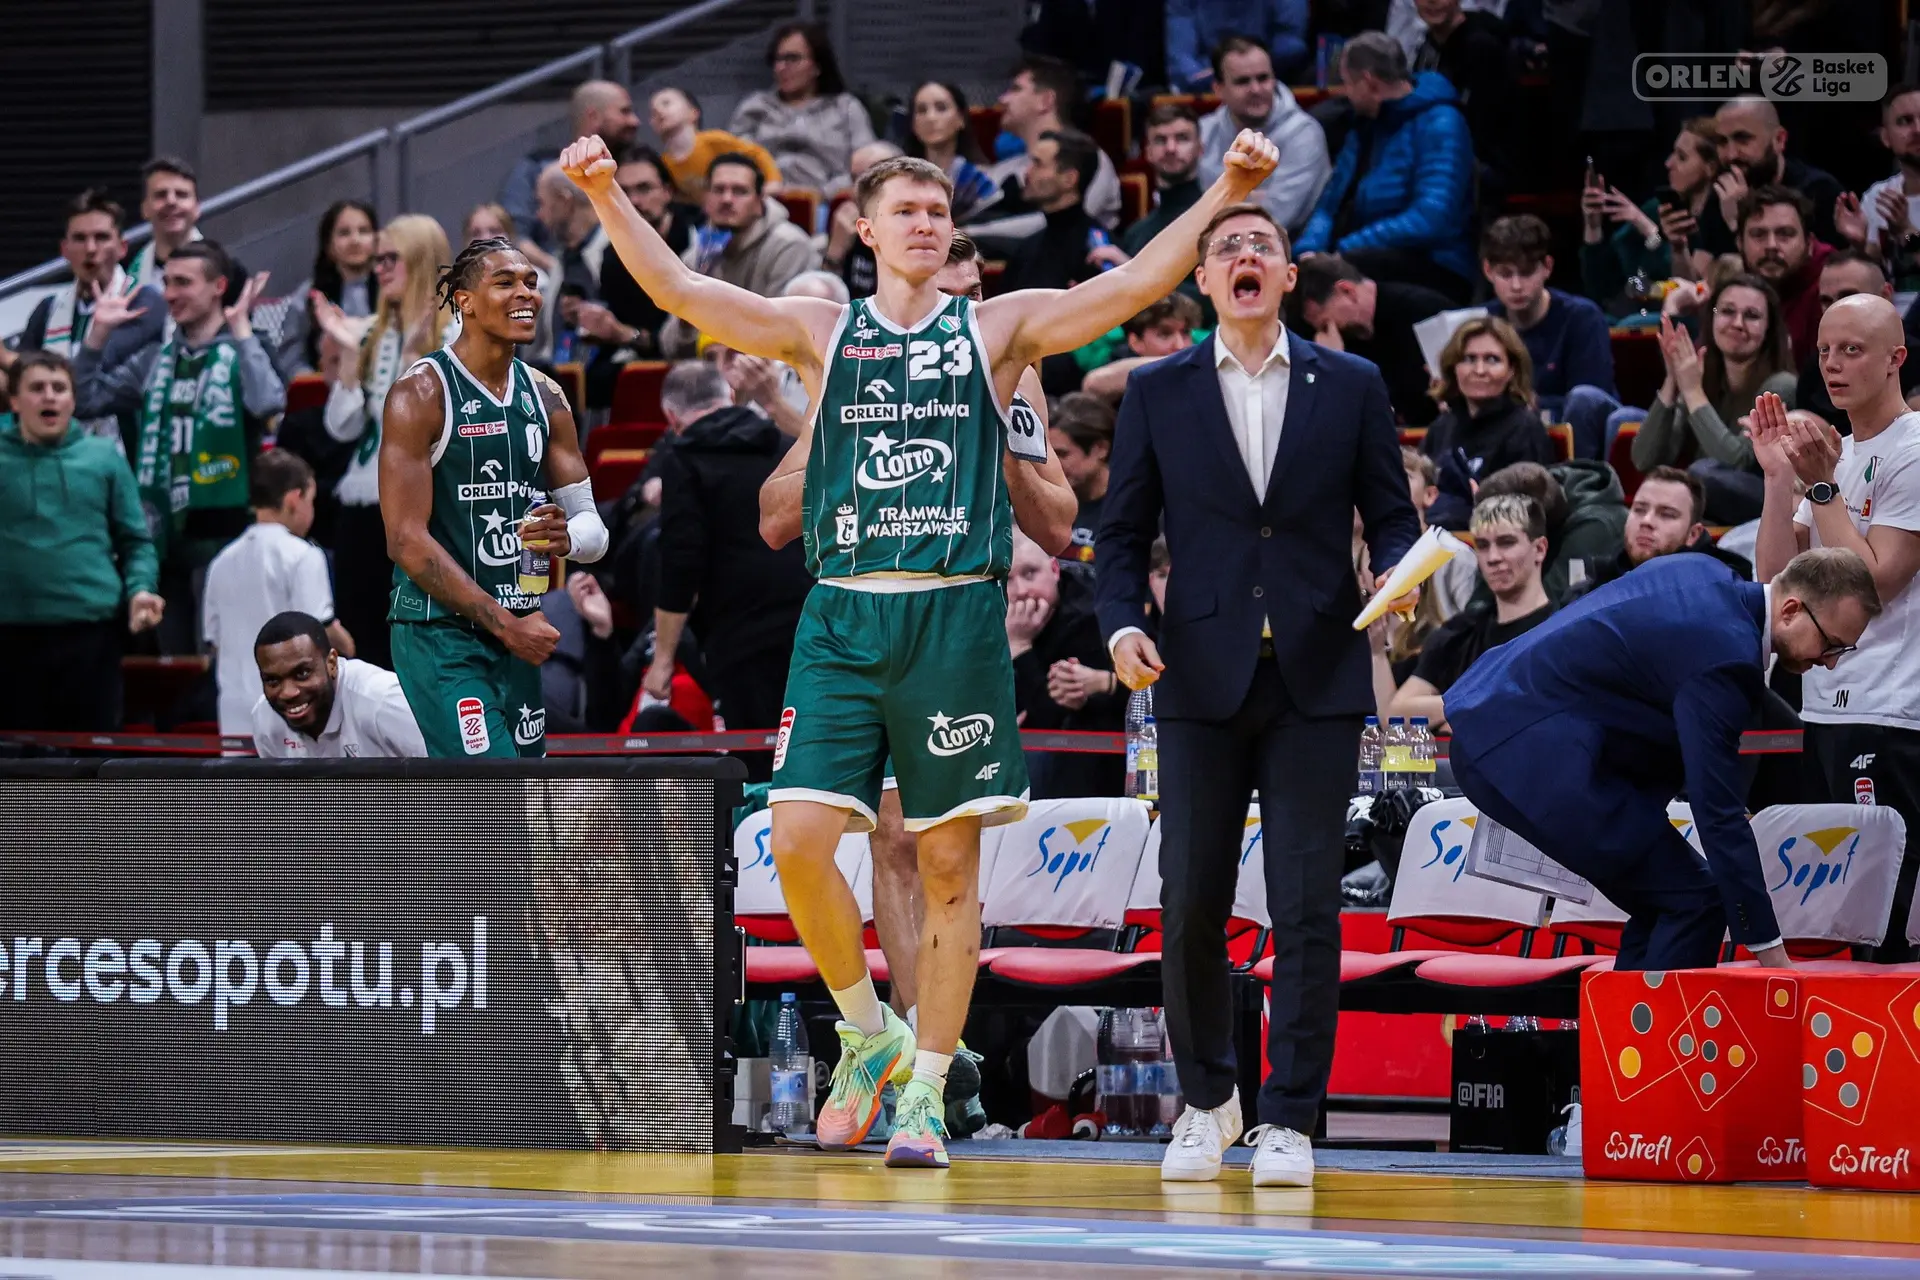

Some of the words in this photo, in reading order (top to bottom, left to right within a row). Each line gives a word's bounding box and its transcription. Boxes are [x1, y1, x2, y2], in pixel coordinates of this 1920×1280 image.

[847, 348, 873, 357] ORLEN
[909, 335, 973, 380] 23
[844, 407, 894, 420] ORLEN
[901, 398, 970, 421] Paliwa
[461, 427, 485, 435] ORLEN
[874, 448, 934, 479] LOTTO
[461, 486, 504, 498] ORLEN
[878, 506, 966, 522] TRAMWAJE
[866, 520, 971, 538] WARSZAWSKI
[460, 704, 481, 712] ORLEN
[1832, 690, 1849, 708] JN
[939, 720, 984, 748] LOTTO
[1850, 754, 1875, 769] 4F
[1027, 825, 1111, 893] Sopot
[1771, 828, 1860, 906] Sopot
[0, 916, 487, 1034] rcesopotu.pl
[1628, 1133, 1672, 1166] Trefl
[1859, 1145, 1910, 1180] Trefl
